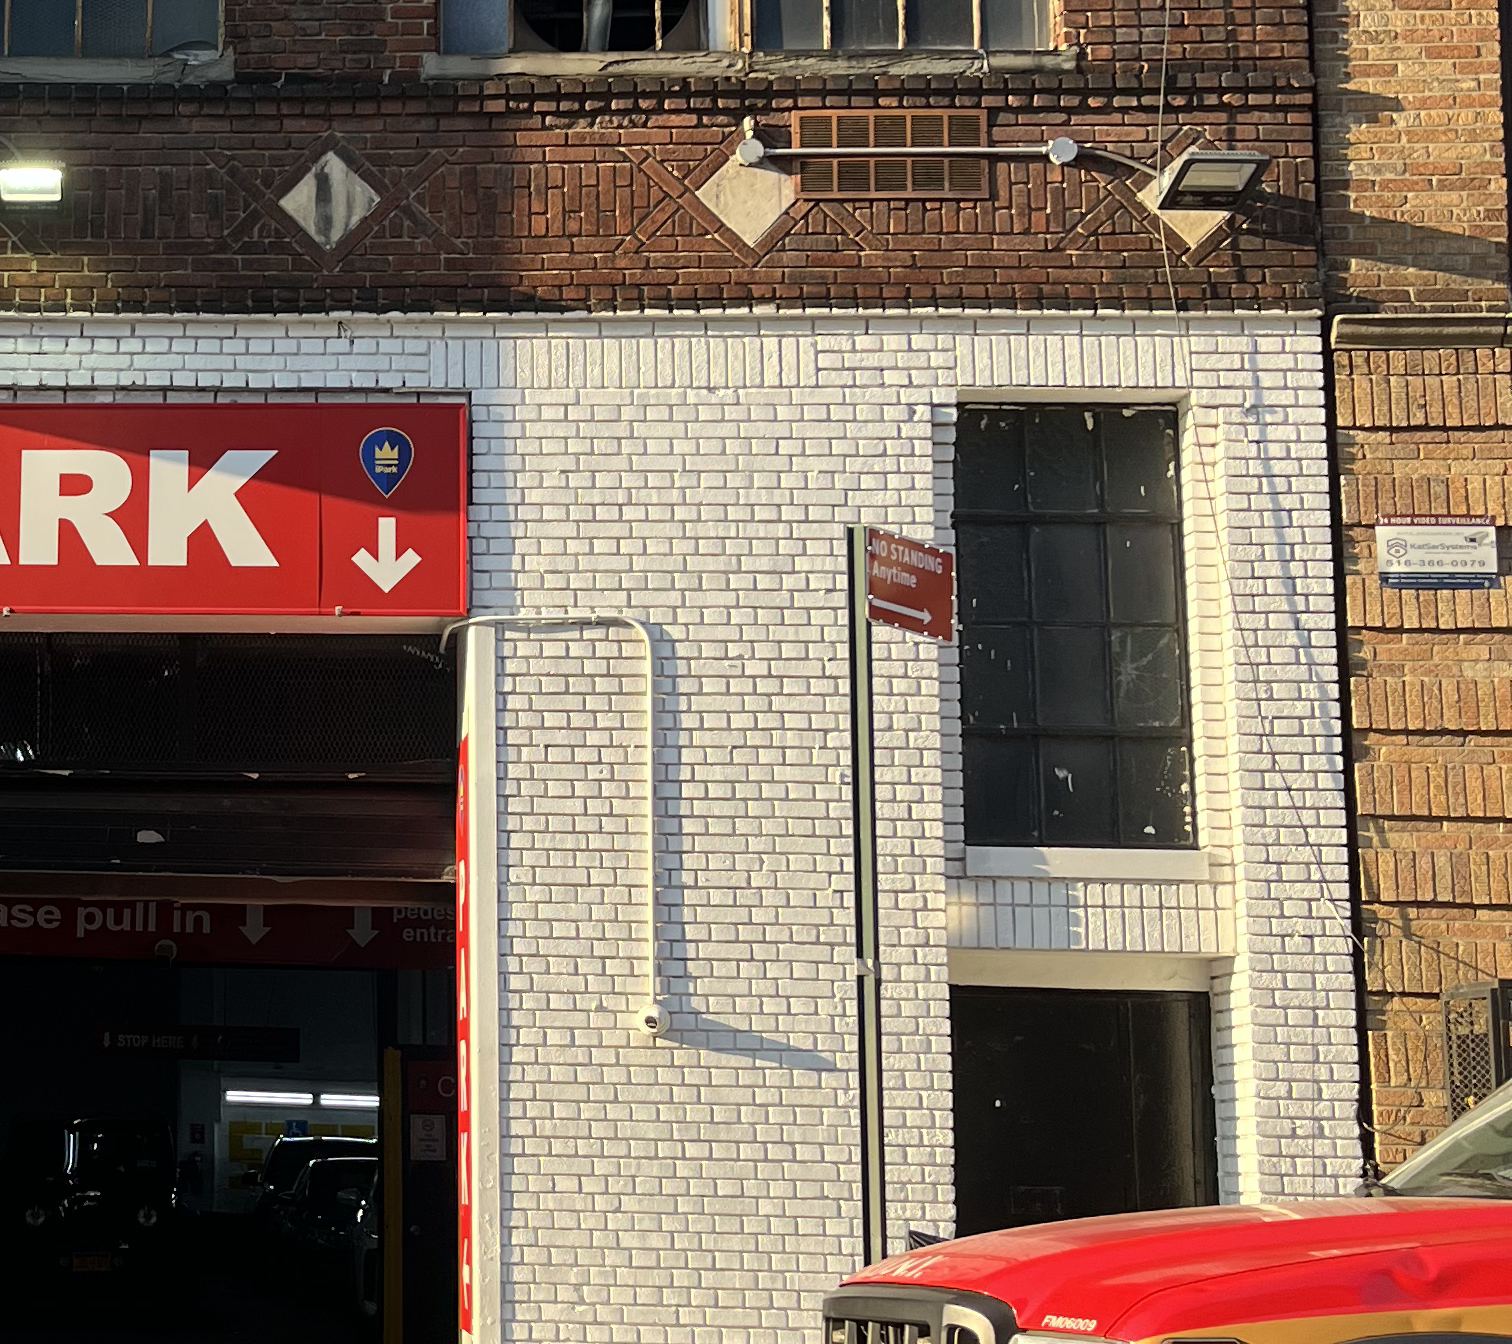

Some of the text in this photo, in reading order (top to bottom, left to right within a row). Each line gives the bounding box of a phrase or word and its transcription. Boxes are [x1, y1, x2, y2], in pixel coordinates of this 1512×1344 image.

[871, 537, 943, 575] NO STANDING
[872, 560, 918, 588] Anytime
[76, 901, 157, 938] pull
[172, 901, 211, 934] in
[118, 1033, 185, 1049] STOP HERE
[1041, 1314, 1098, 1332] FM06009
